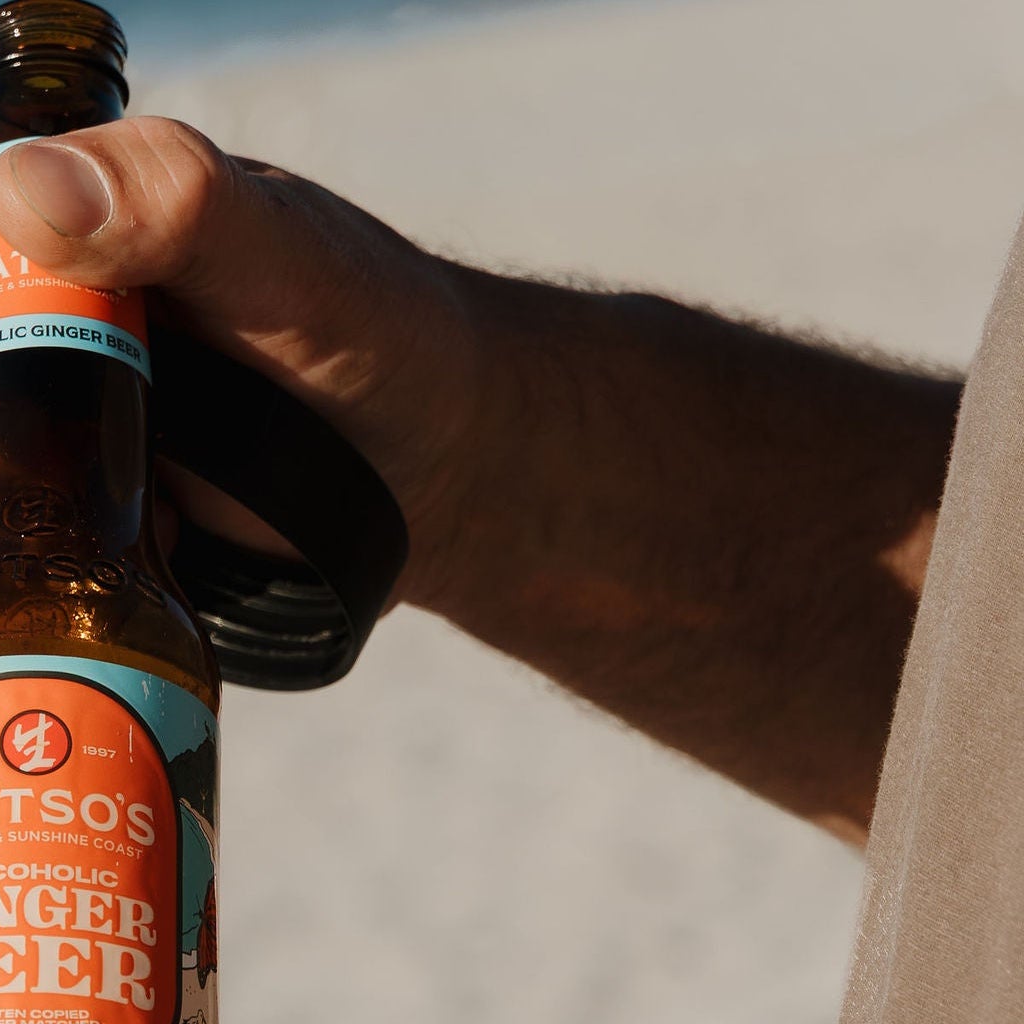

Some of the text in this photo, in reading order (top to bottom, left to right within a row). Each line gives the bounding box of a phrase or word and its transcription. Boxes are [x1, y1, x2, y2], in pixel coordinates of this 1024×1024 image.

[7, 281, 15, 290] &
[31, 324, 102, 344] GINGER
[106, 333, 142, 363] BEER
[82, 745, 117, 759] 1997
[8, 830, 89, 847] SUNSHINE
[94, 838, 143, 860] COAST
[30, 1009, 89, 1020] COPIED
